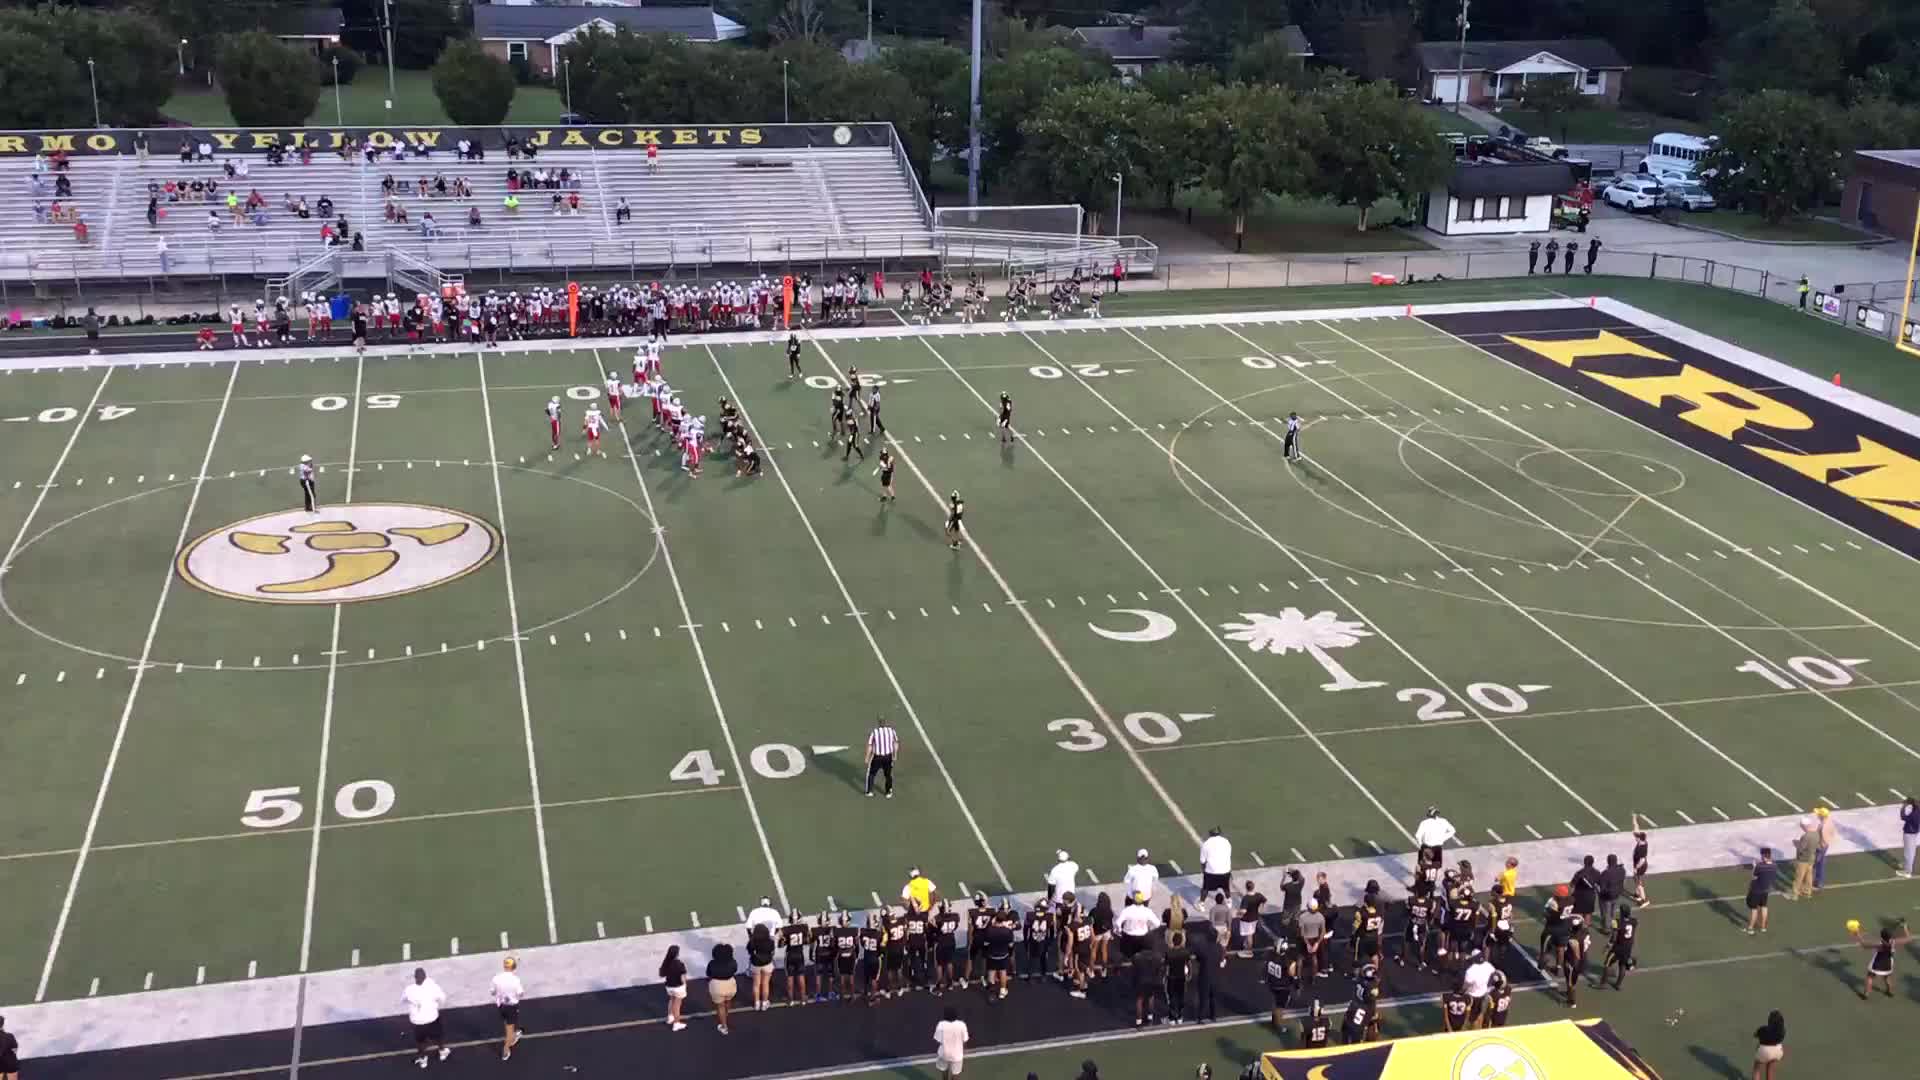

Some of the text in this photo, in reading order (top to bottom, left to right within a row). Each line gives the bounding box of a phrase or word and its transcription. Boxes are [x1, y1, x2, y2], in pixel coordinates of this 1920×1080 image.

[212, 131, 442, 150] YELLOW
[532, 128, 763, 147] JACKETS
[1241, 355, 1312, 369] 10
[1029, 363, 1109, 379] 20
[804, 373, 887, 389] 30
[311, 394, 402, 412] 50
[38, 405, 137, 424] 40
[1736, 655, 1856, 690] 10
[1396, 682, 1529, 721] 20
[1046, 711, 1182, 752] 30
[669, 743, 807, 786] 40
[240, 780, 396, 828] 50
[1455, 908, 1473, 920] 77
[975, 916, 991, 929] 47
[790, 933, 803, 946] 21
[1624, 924, 1633, 939] 3
[1353, 1008, 1366, 1025] 5
[1449, 1001, 1466, 1016] 33
[1312, 1026, 1326, 1041] 15
